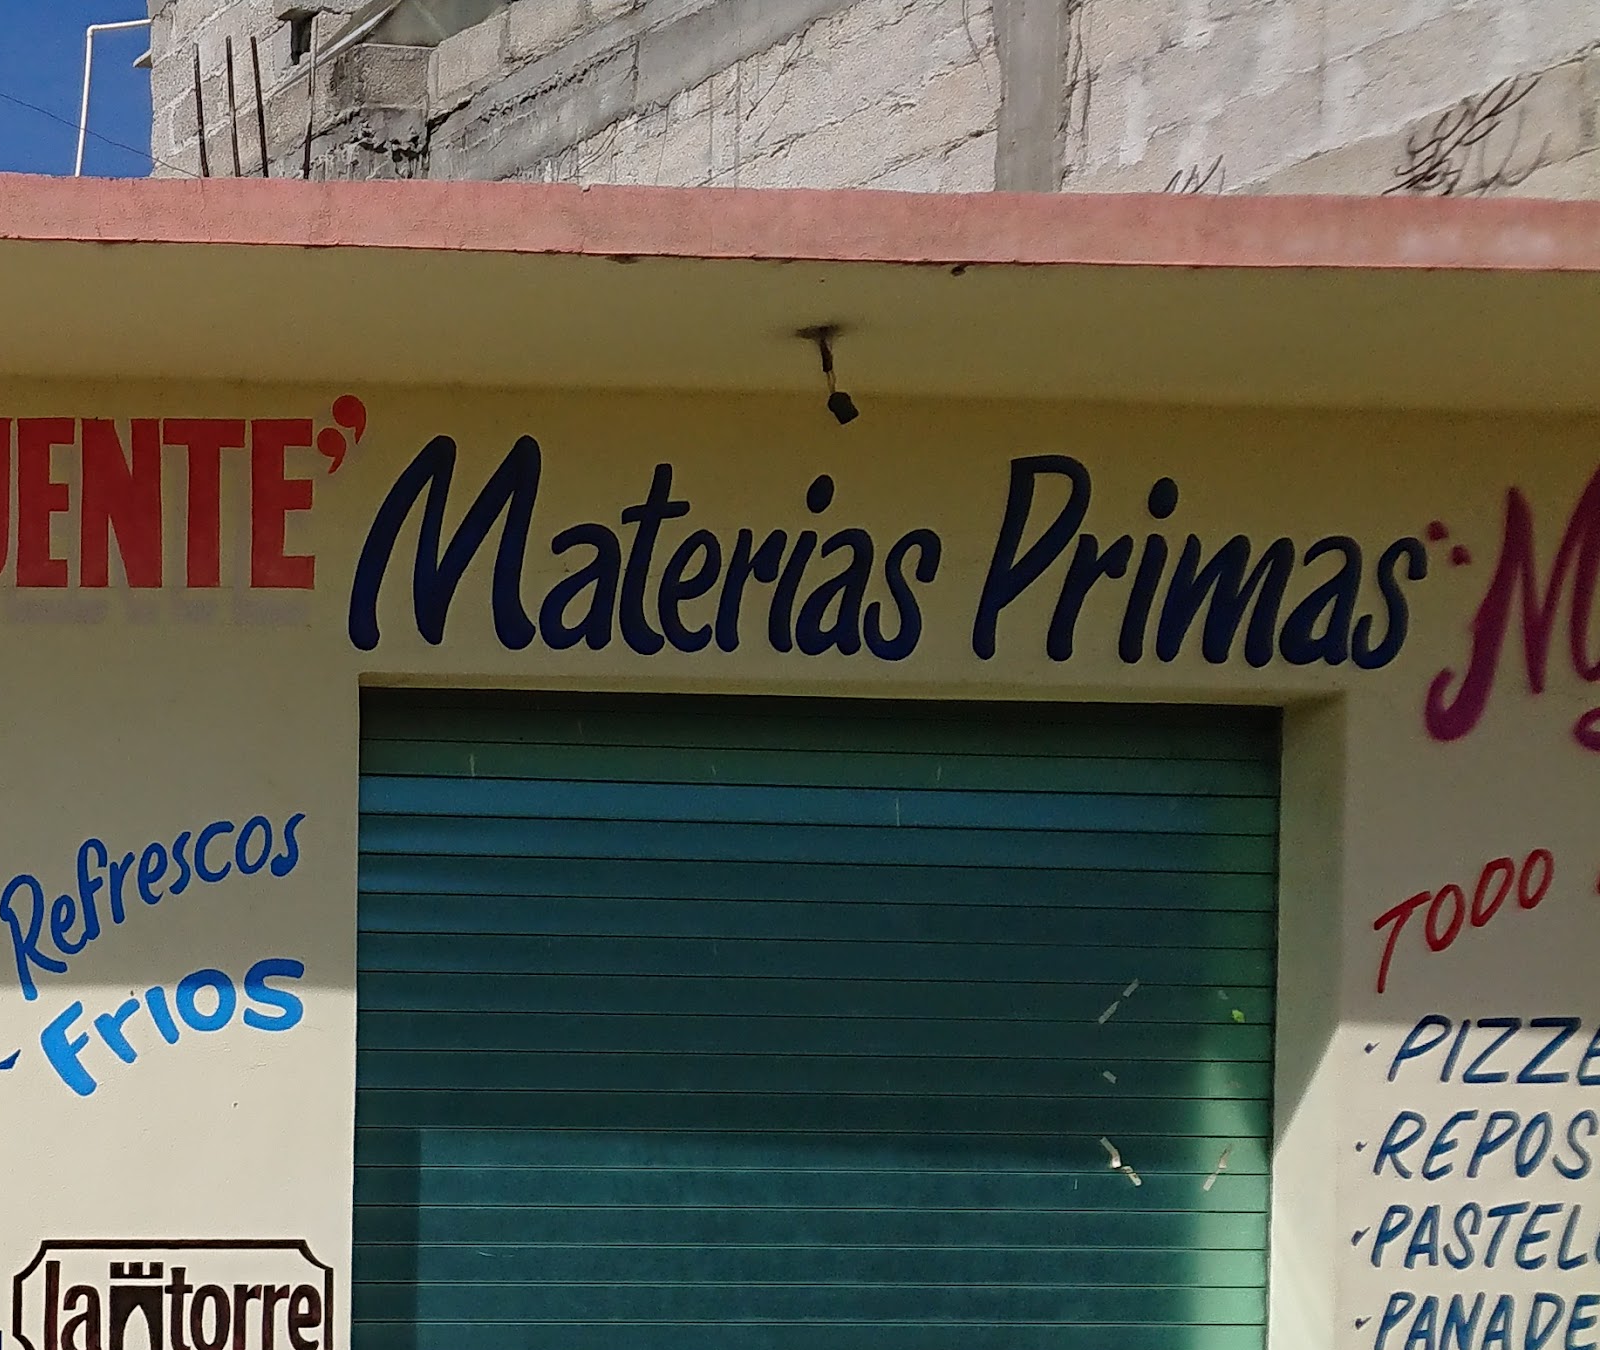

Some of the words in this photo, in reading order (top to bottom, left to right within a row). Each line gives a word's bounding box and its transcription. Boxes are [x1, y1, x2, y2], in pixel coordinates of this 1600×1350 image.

[346, 434, 942, 662] Materias
[971, 454, 1428, 671] Primas
[0, 813, 306, 1000] Refrescos
[1373, 848, 1554, 994] TODO
[1373, 1109, 1599, 1181] REPOS
[1370, 1201, 1600, 1271] PASTEL
